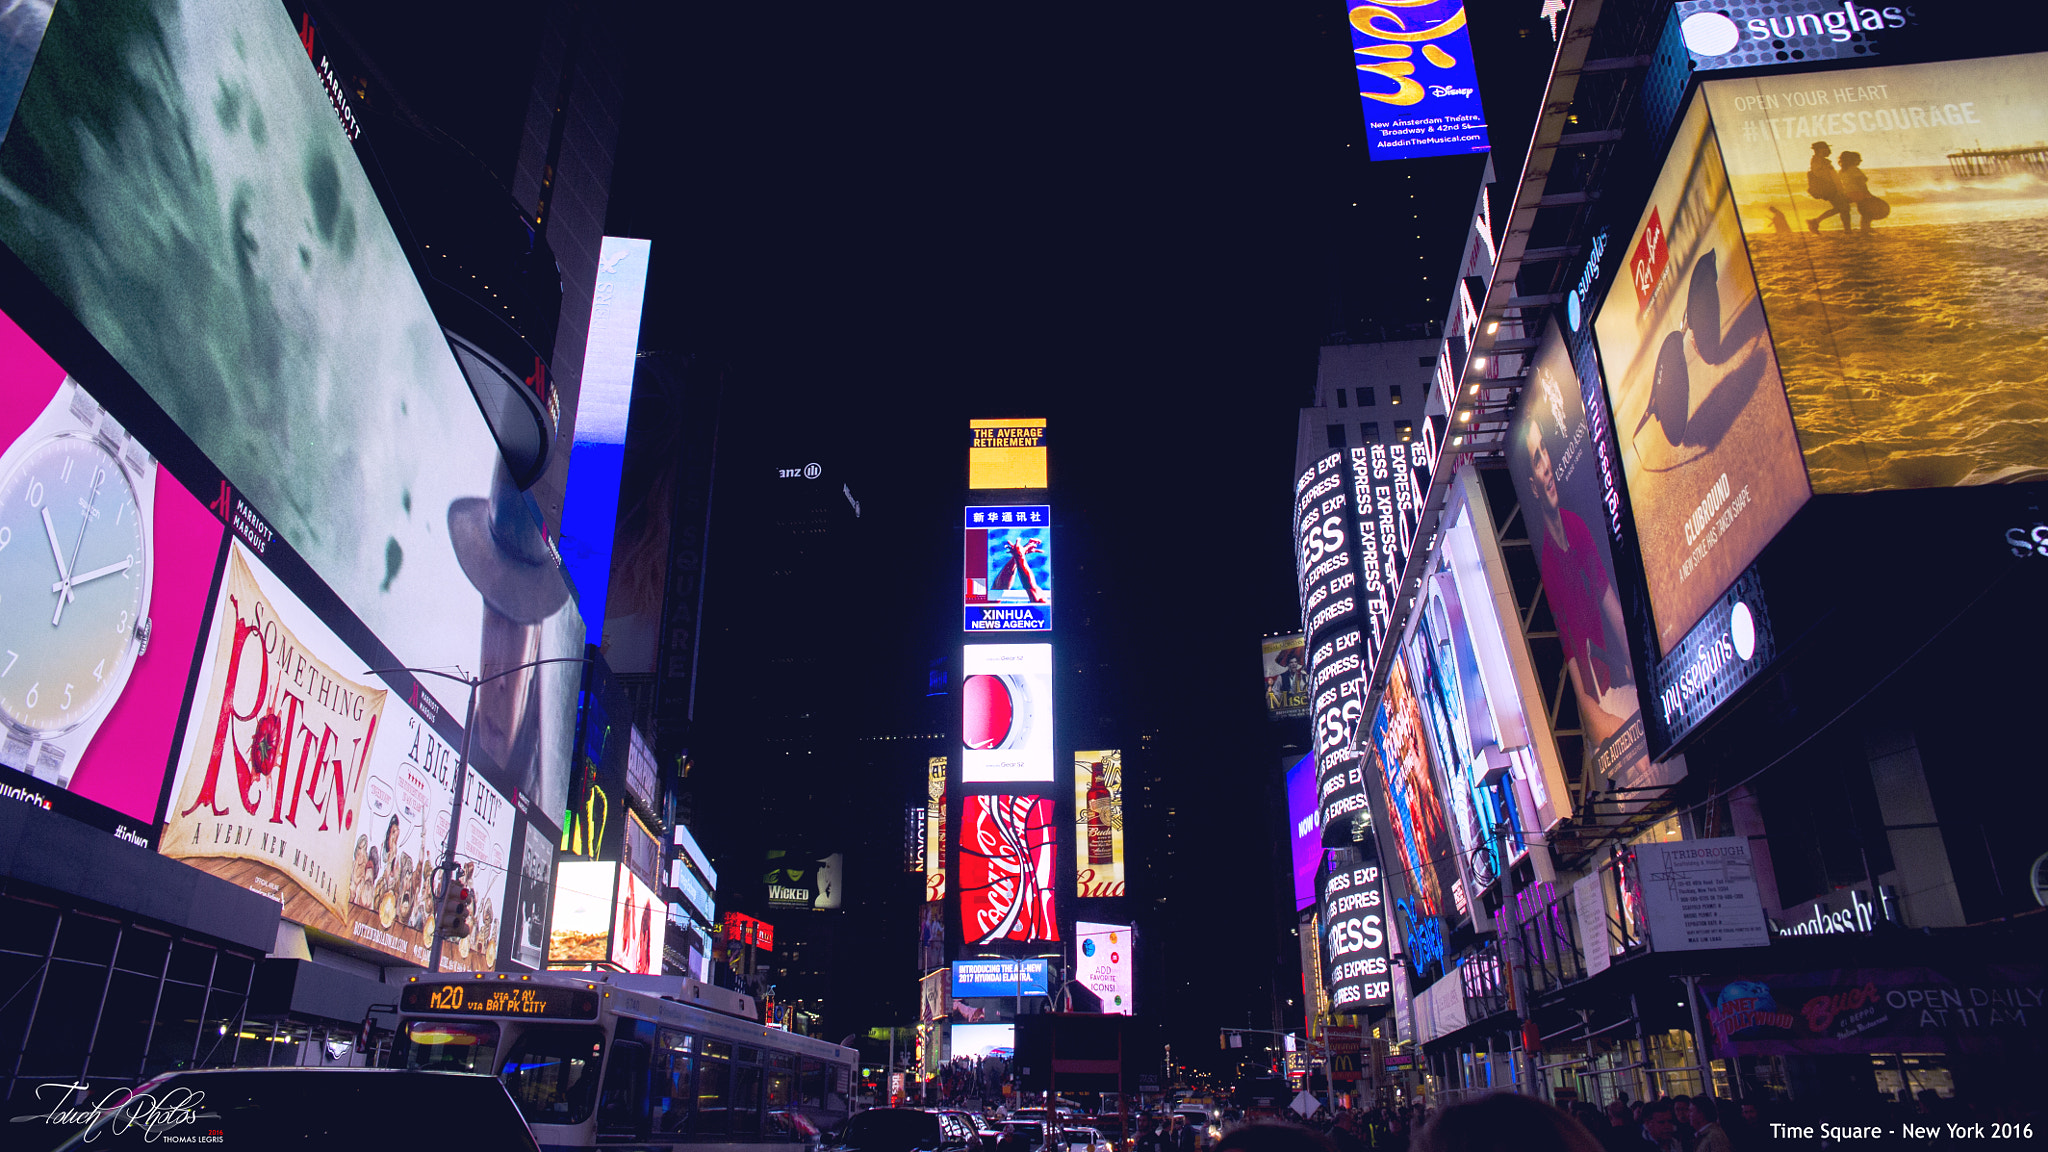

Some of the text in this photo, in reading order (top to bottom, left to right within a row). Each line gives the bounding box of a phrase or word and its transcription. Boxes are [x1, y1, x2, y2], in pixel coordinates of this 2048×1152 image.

[321, 56, 360, 139] MARRIOTT
[1428, 85, 1473, 98] Disney
[1735, 85, 1888, 112] OPEN YOUR HEART
[1382, 127, 1426, 137] Broadway
[1437, 124, 1459, 132] 42nd
[1393, 117, 1443, 127] Amsterdam
[1742, 102, 1980, 142] #ITTAKESCOURAGE
[1377, 134, 1481, 148] AladdinTheMusical.com
[974, 428, 1043, 438] THE AVERAGE
[974, 438, 1038, 447] RETIREMENT
[1351, 447, 1374, 515] EXPRESS
[1390, 444, 1412, 511] EXPRESS
[25, 475, 44, 507] 10
[1301, 474, 1341, 510] EXPRESS
[236, 499, 273, 542] MARRIOTT
[973, 511, 1042, 524] 新华通讯社
[1376, 486, 1397, 555] EXPRESS
[1684, 472, 1730, 546] CLUBROUND
[232, 515, 266, 553] MARQUIS
[1692, 540, 1708, 567] STYLE
[1706, 527, 1719, 550] HAS
[1716, 508, 1734, 536] TAKEN
[1732, 484, 1752, 518] SHAPE
[1360, 521, 1382, 592] EXPRESS
[1309, 552, 1349, 586] EXPRESS
[972, 620, 1045, 629] NEWS AGENCY
[983, 609, 1033, 620] XINHUA
[1313, 598, 1354, 631] EXPRESS
[252, 601, 365, 721] SOMETHING
[1318, 654, 1360, 688] EXPRESS
[1660, 633, 1733, 725] sunglass hut
[181, 594, 376, 834] ROTTEN!
[1611, 719, 1644, 763] AUTHENTIC
[1298, 813, 1314, 839] NOW
[192, 823, 201, 844] A
[214, 823, 252, 847] VERY
[260, 832, 287, 858] NEW
[293, 849, 338, 904] MUSICAL
[1672, 846, 1744, 859] TRIBOROUGH
[1354, 867, 1379, 887] EXP
[768, 885, 809, 901] WICKED
[1338, 890, 1381, 914] EXPRES
[1397, 894, 1446, 977] Disney
[959, 963, 1042, 974] INTRODUCING THE AL-NEW
[959, 974, 974, 983] 2017
[974, 973, 1002, 982] HYUNDAI
[1090, 974, 1116, 982] FAVORITE
[1096, 966, 1112, 974] ADD
[1344, 957, 1388, 980] EXPRES
[430, 986, 464, 1010] M20
[494, 989, 536, 1002] VIA 7 AV
[1364, 981, 1390, 1000] EXP
[1886, 987, 2045, 1009] OPEN DAILY
[468, 999, 547, 1013] VIA BAT PK CITY
[1920, 1007, 2027, 1028] AT 11 AM
